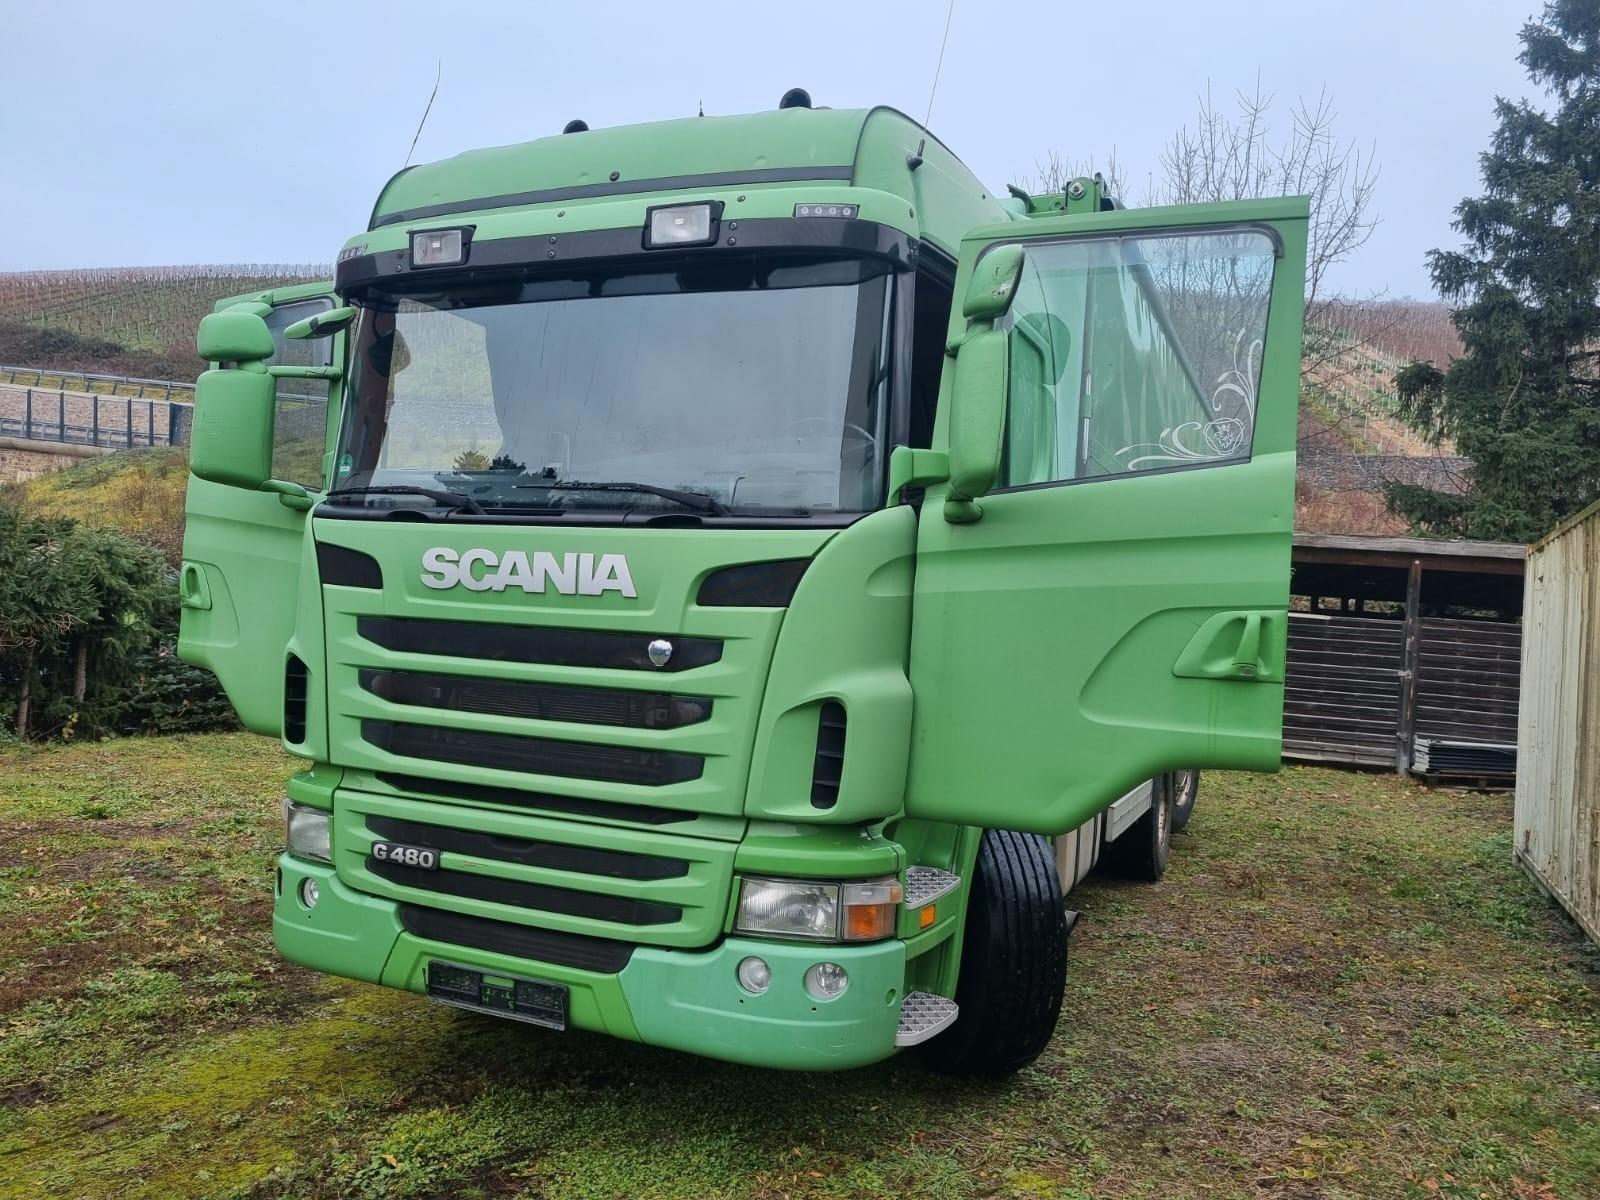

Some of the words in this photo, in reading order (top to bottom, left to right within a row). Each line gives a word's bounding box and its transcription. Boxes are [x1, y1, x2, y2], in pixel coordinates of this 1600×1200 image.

[420, 547, 638, 598] SCANIA
[373, 843, 388, 860] G
[390, 847, 434, 868] 480
